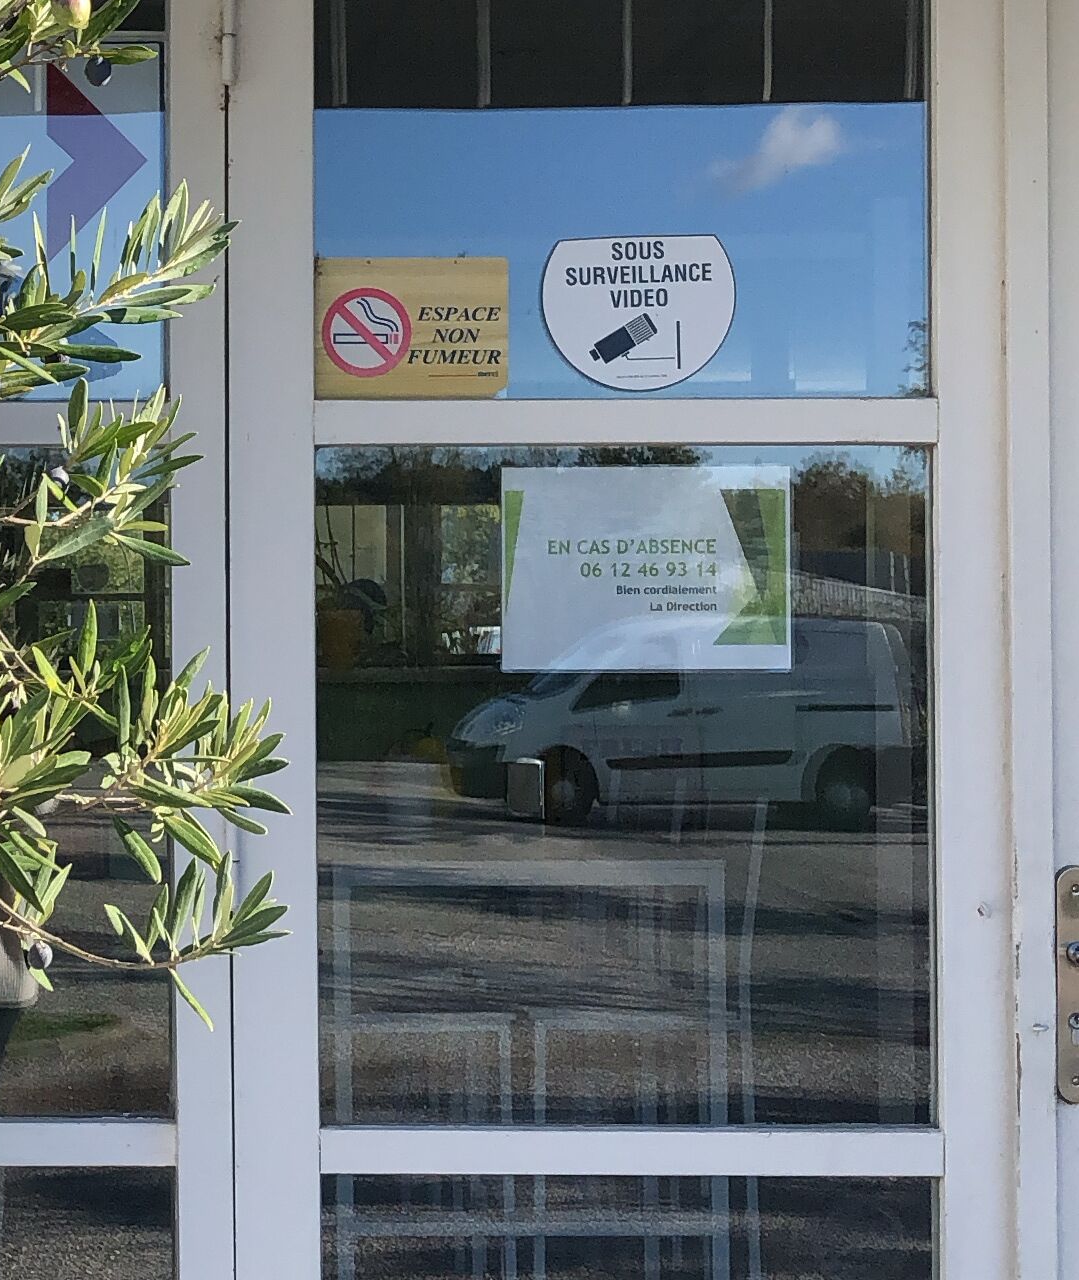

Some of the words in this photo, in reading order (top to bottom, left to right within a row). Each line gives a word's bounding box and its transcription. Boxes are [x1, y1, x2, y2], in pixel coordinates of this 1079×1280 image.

[611, 240, 665, 261] SOUS
[565, 263, 712, 286] SURVEILLANCE
[610, 288, 668, 308] VIDEO
[419, 306, 501, 322] ESPACE
[433, 328, 480, 344] NON
[408, 349, 501, 365] FUMEUR
[547, 540, 570, 555] EN
[577, 540, 610, 555] CAS
[617, 538, 717, 555] D’ABSENCE
[580, 562, 602, 578] 06
[611, 563, 630, 577] 12
[637, 562, 659, 577] 46
[665, 562, 687, 577] 93
[696, 561, 717, 577] 14
[616, 585, 640, 595] Bien
[643, 585, 717, 595] cordialement
[649, 602, 663, 612] La
[666, 602, 717, 612] Direction
